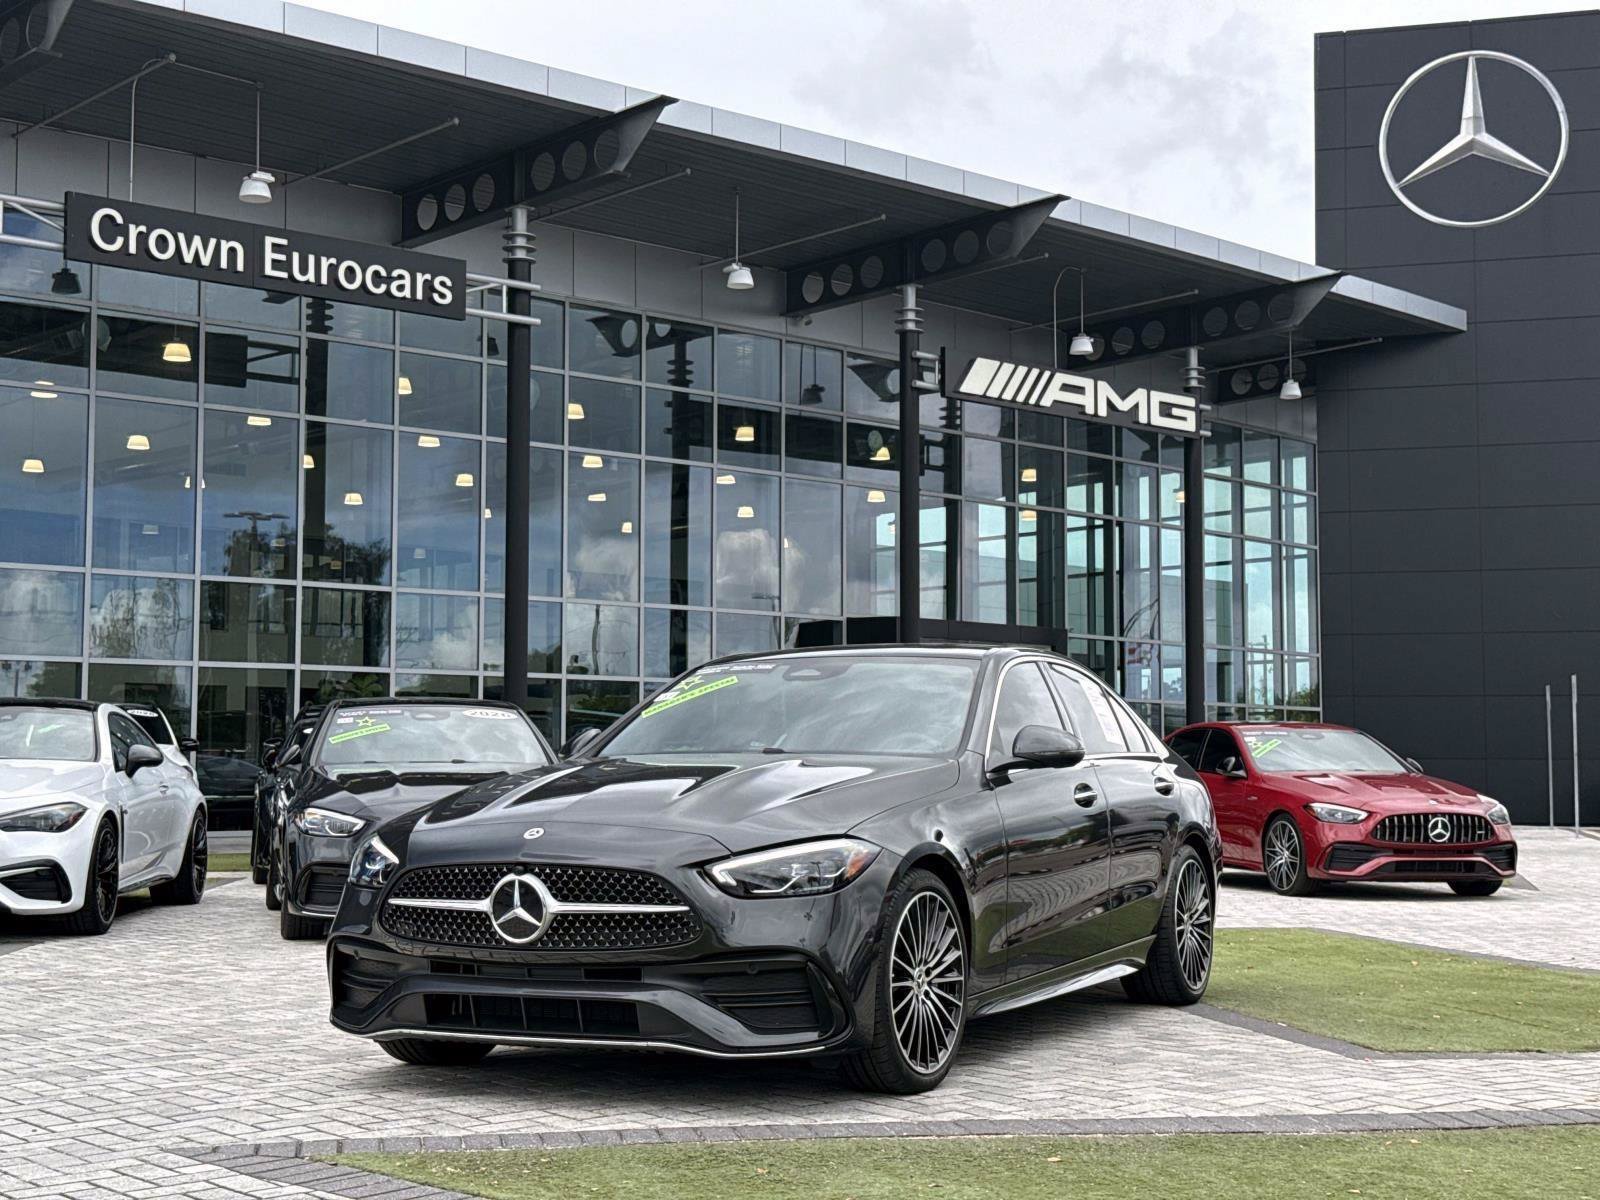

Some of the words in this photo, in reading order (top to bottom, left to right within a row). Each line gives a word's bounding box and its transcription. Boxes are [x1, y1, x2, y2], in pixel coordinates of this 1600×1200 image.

[89, 207, 245, 273] Crown
[263, 235, 454, 305] Eurocars
[1040, 372, 1196, 432] AMG
